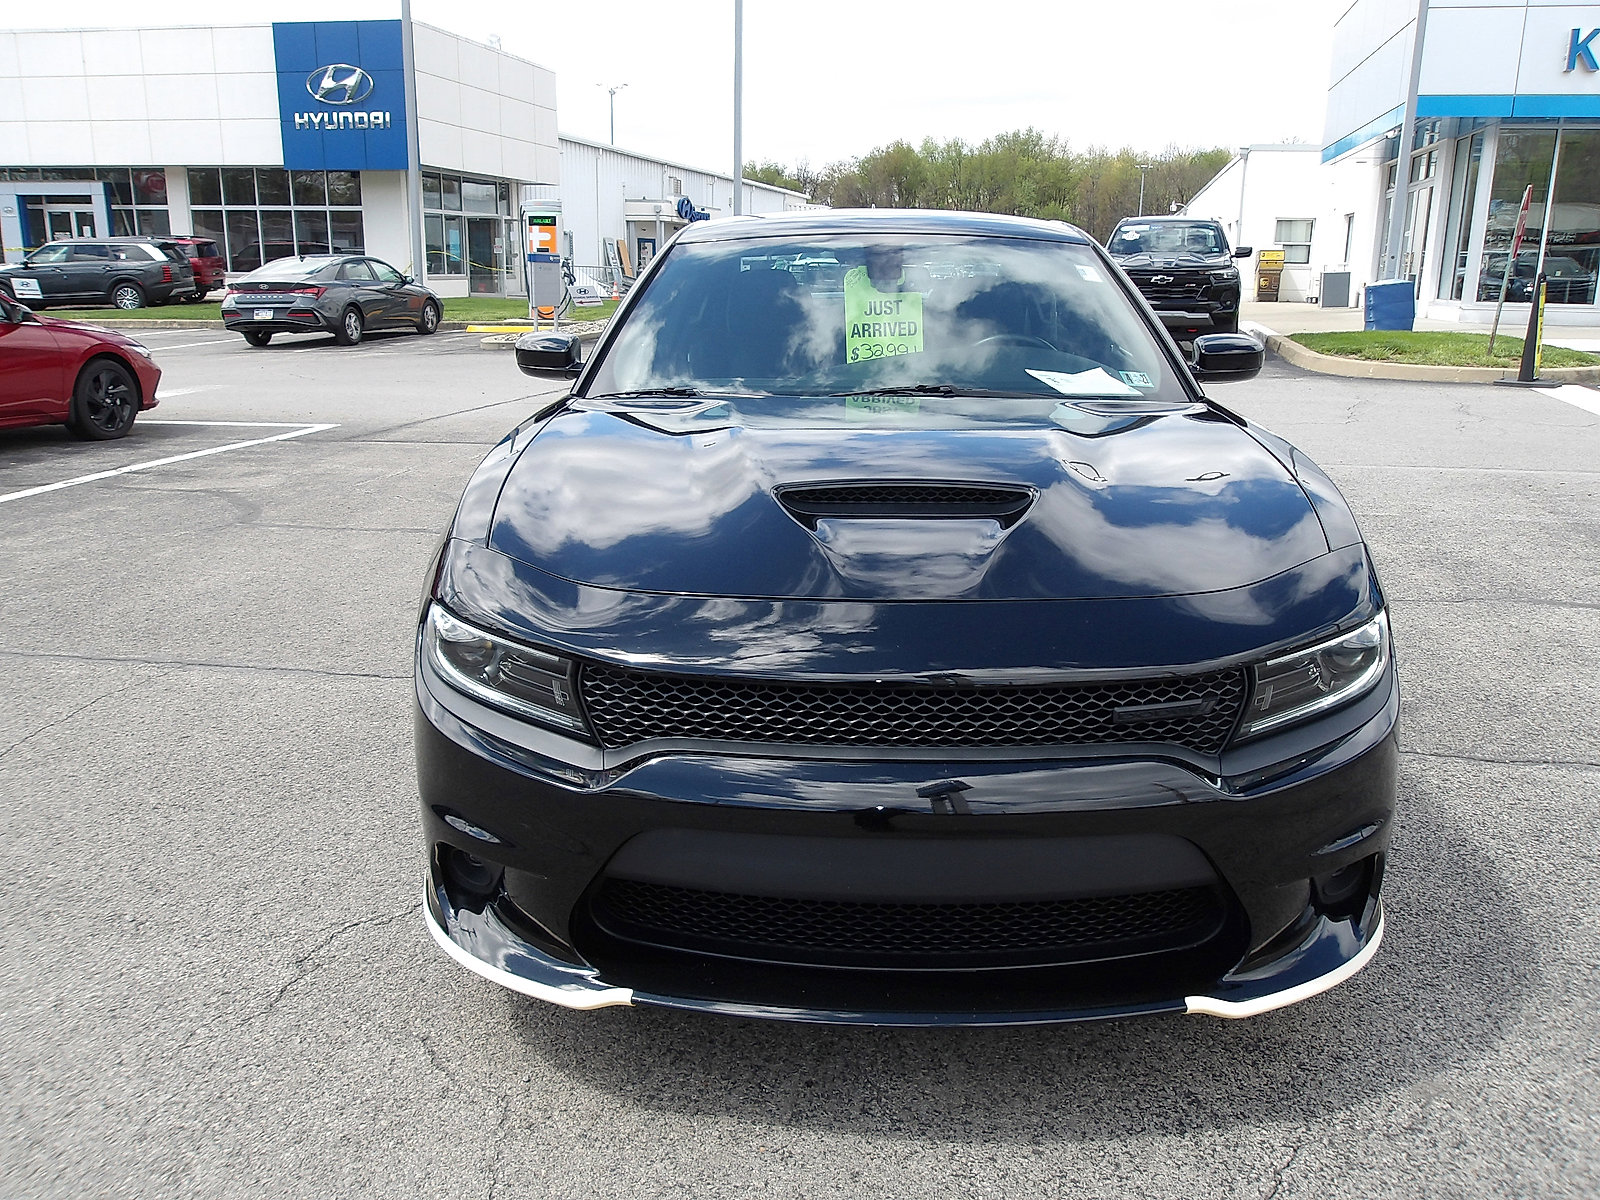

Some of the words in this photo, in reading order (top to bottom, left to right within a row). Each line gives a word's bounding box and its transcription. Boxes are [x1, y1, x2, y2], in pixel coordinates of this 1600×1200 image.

[294, 111, 391, 130] HYUNDAI
[864, 300, 903, 316] JUST
[850, 321, 918, 339] ARRIVED
